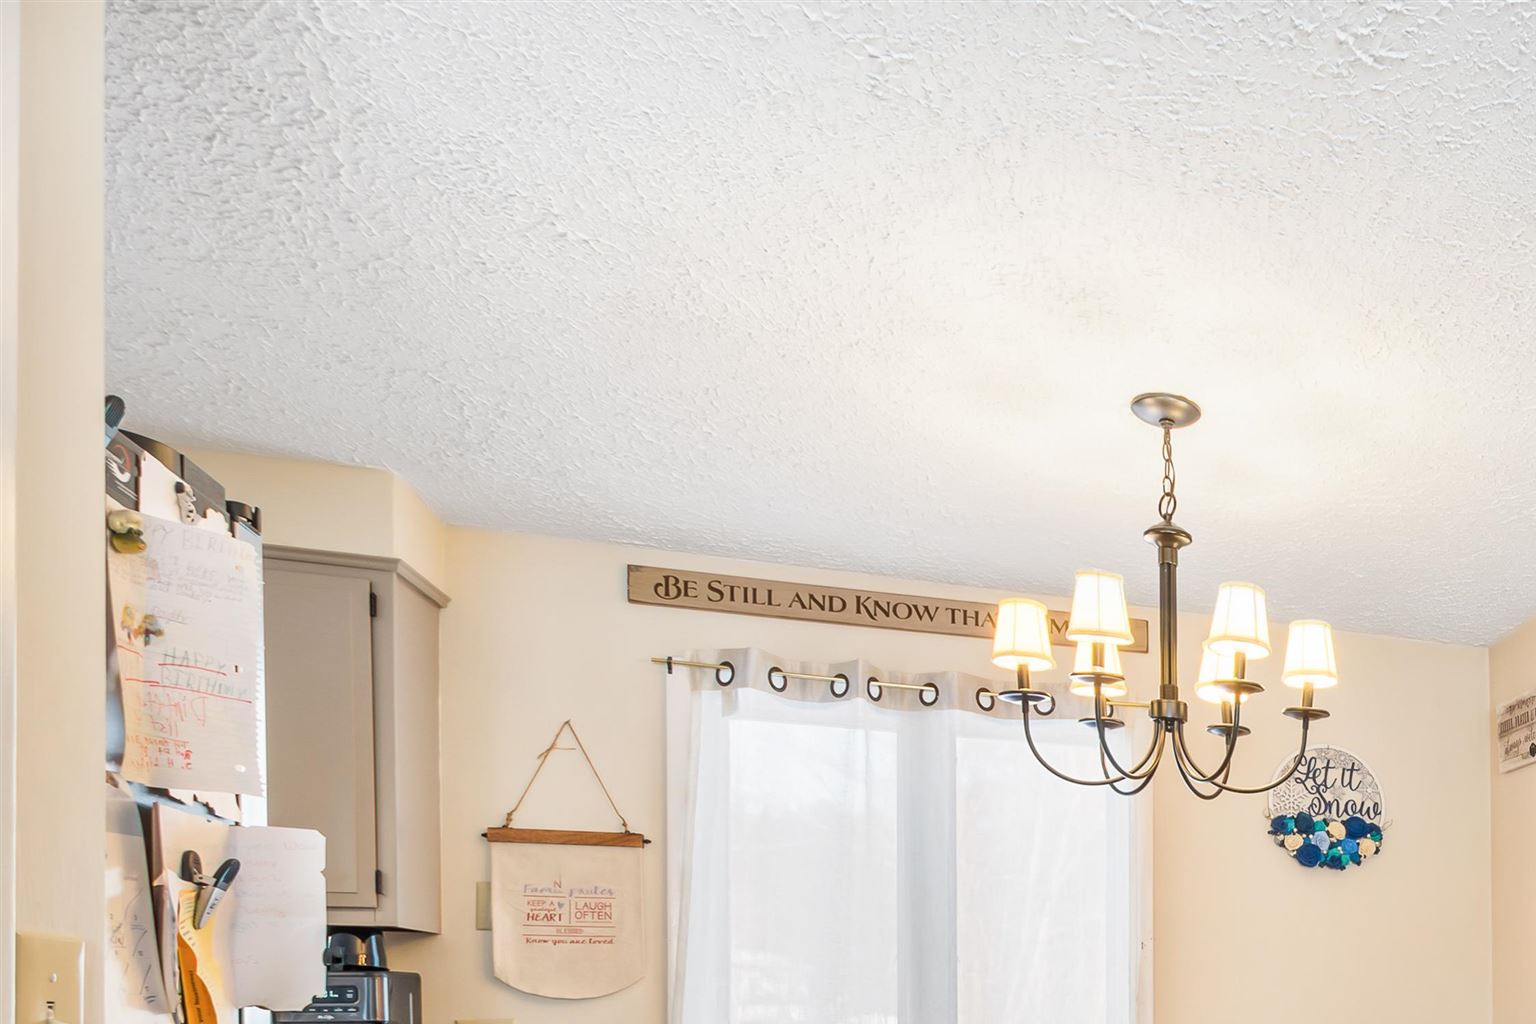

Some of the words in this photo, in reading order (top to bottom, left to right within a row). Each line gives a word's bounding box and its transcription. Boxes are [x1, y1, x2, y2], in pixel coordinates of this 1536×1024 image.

[653, 575, 698, 600] BE
[706, 580, 781, 603] STILL
[788, 592, 847, 613] AND
[855, 595, 940, 621] KNOW
[945, 607, 996, 628] THA
[1294, 754, 1337, 794] Let
[1341, 762, 1362, 791] it
[1308, 785, 1382, 819] Snow
[574, 911, 613, 920] OFTEN
[575, 902, 612, 911] LAUGH
